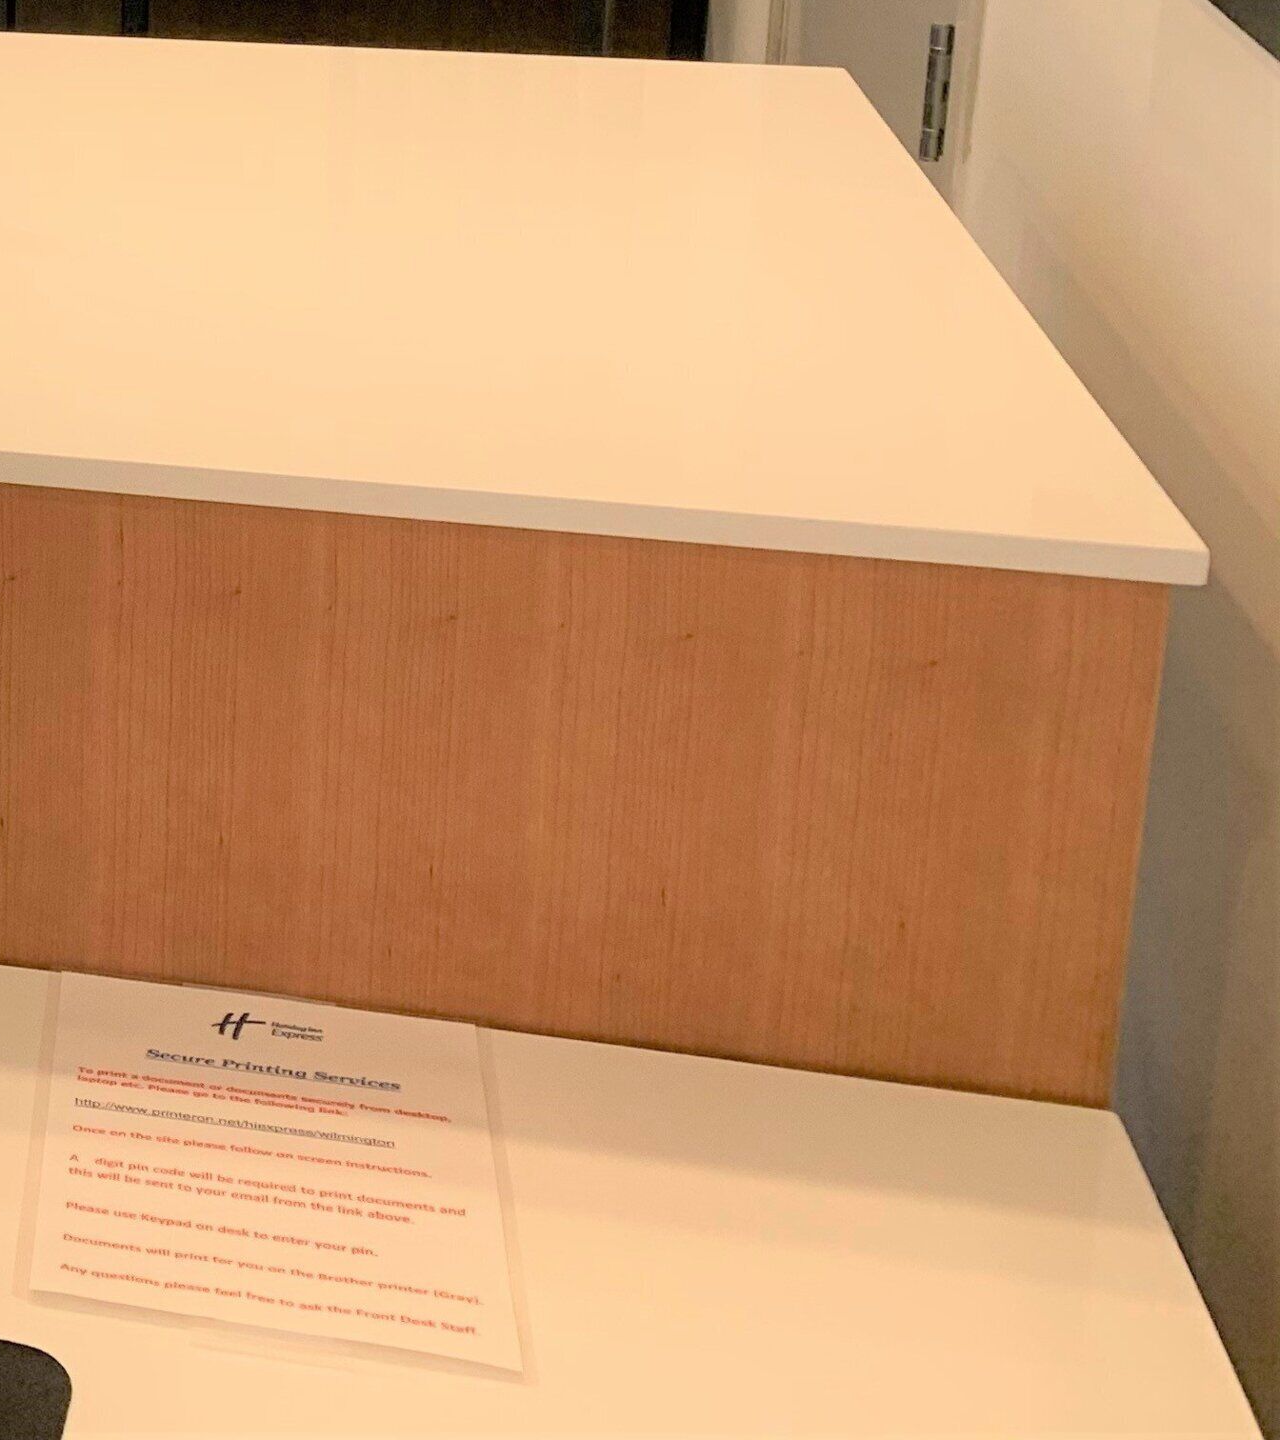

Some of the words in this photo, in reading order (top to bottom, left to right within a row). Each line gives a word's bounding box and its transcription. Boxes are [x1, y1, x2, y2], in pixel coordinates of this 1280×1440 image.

[271, 1028, 324, 1043] Express
[77, 1066, 93, 1075] To
[96, 1068, 127, 1080] print
[141, 1074, 205, 1089] document
[209, 1083, 223, 1091] or
[226, 1085, 298, 1101] documents
[301, 1095, 355, 1110] securely
[359, 1102, 391, 1114] from
[77, 1074, 118, 1087] laptop
[121, 1081, 144, 1090] etc.
[147, 1084, 190, 1096] Please
[192, 1091, 209, 1100] go
[212, 1093, 226, 1101] to
[229, 1095, 251, 1104] the
[254, 1098, 315, 1114] following
[146, 1048, 216, 1066] Secure
[221, 1058, 308, 1080] Printing
[313, 1070, 402, 1091] Services
[72, 1124, 106, 1136] Once
[109, 1129, 127, 1139] on
[130, 1131, 152, 1141] the
[156, 1135, 180, 1145] site
[183, 1138, 227, 1152] please
[230, 1145, 273, 1157] follow
[276, 1152, 294, 1160] on
[297, 1154, 342, 1167] screen
[345, 1159, 432, 1179] instructions.
[68, 1167, 93, 1179] this
[97, 1172, 121, 1183] will
[124, 1175, 141, 1185] be
[144, 1179, 174, 1190] sent
[177, 1183, 192, 1193] to
[195, 1186, 228, 1198] your
[230, 1190, 269, 1204] email
[273, 1196, 307, 1209] from
[310, 1201, 334, 1213] the
[337, 1205, 364, 1218] link
[367, 1210, 416, 1225] above.
[69, 1154, 79, 1162] A
[94, 1157, 125, 1170] digit
[128, 1162, 150, 1174] pin
[153, 1165, 186, 1178] code
[189, 1172, 213, 1182] will
[217, 1174, 234, 1184] be
[238, 1178, 297, 1193] required
[301, 1186, 316, 1196] to
[319, 1189, 354, 1202] print
[356, 1194, 436, 1213] documents
[440, 1206, 467, 1217] and
[65, 1201, 110, 1216] Please
[113, 1210, 137, 1221] use
[140, 1212, 192, 1229] Keypad
[195, 1222, 214, 1232] on
[217, 1225, 250, 1238] desk
[253, 1230, 269, 1240] to
[272, 1234, 311, 1246] enter
[314, 1240, 348, 1253] your
[351, 1245, 379, 1257] pin.
[62, 1232, 142, 1253] Documents
[145, 1247, 170, 1258] will
[174, 1250, 209, 1263] print
[213, 1255, 234, 1266] for
[237, 1260, 264, 1272] you
[267, 1266, 287, 1275] on
[290, 1268, 314, 1280] the
[318, 1272, 374, 1288] Brother
[377, 1281, 430, 1296] printer
[59, 1262, 88, 1277] Any
[90, 1270, 161, 1288] questions
[163, 1281, 211, 1294] please
[214, 1287, 242, 1299] feel
[245, 1291, 275, 1305] free
[279, 1298, 295, 1308] to
[298, 1302, 322, 1312] ask
[326, 1305, 353, 1316] the
[355, 1308, 396, 1322] Front
[400, 1314, 437, 1329] Desk
